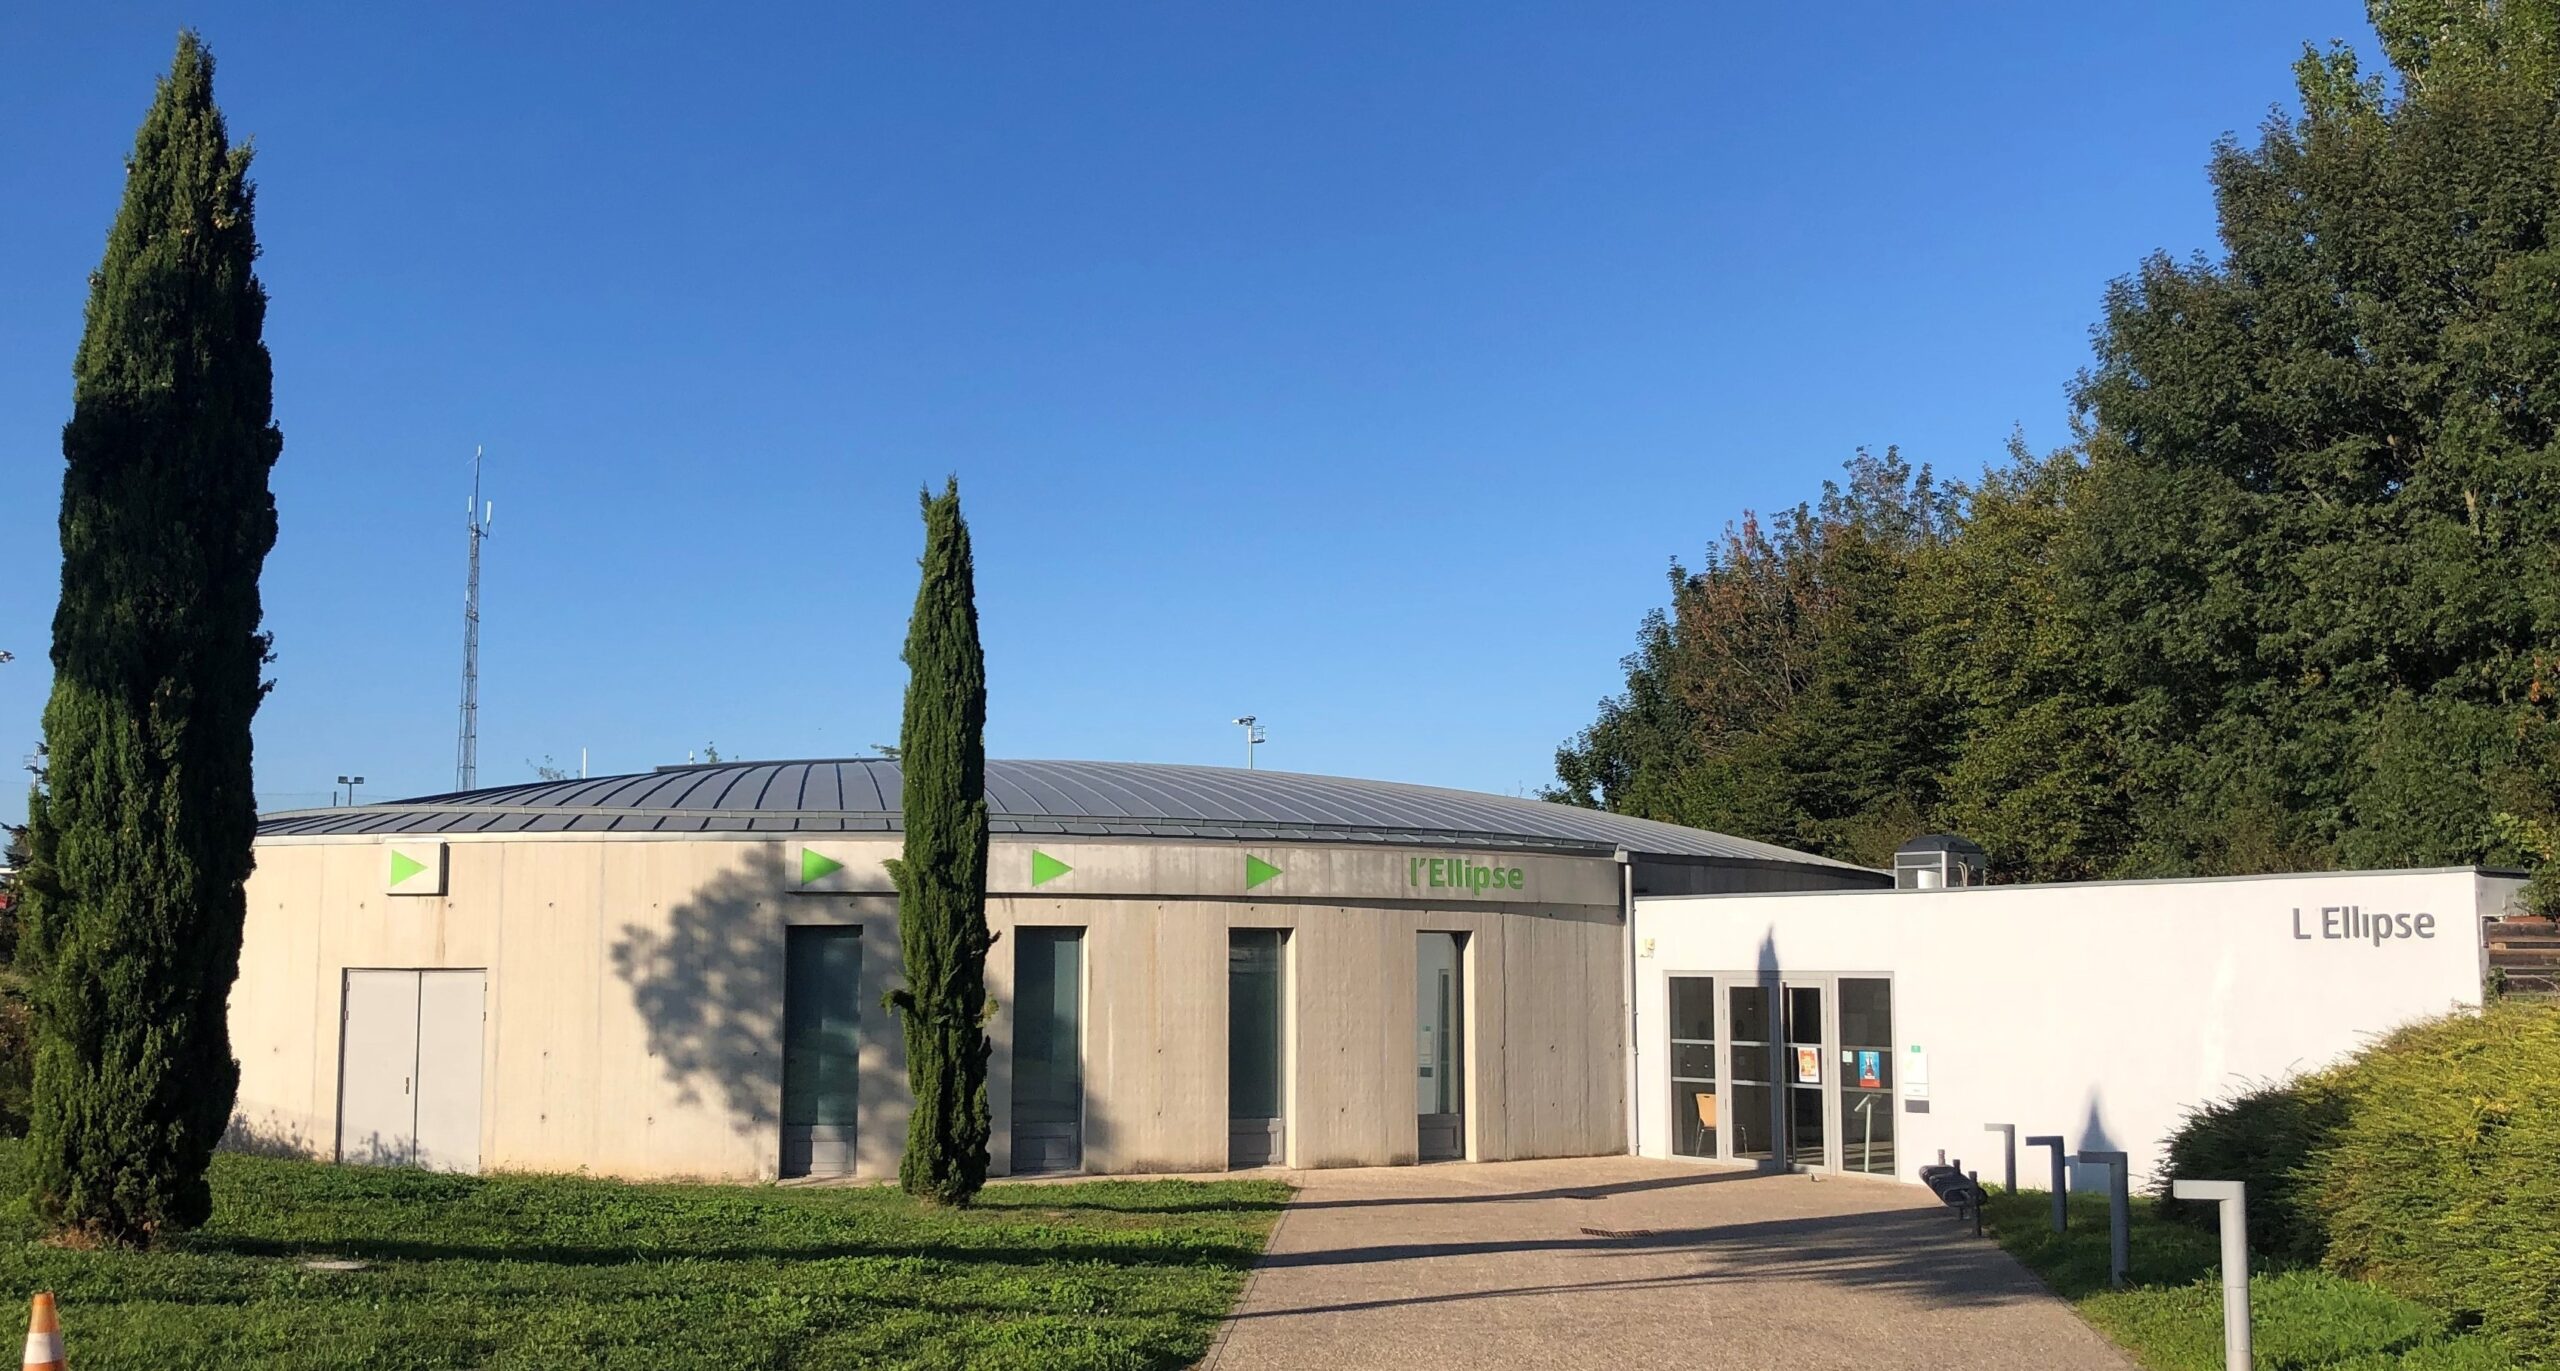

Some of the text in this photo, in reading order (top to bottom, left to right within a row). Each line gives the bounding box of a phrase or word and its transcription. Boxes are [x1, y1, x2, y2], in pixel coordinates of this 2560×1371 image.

[1410, 857, 1524, 896] l'Ellipse
[2292, 905, 2436, 948] L Ellipse
